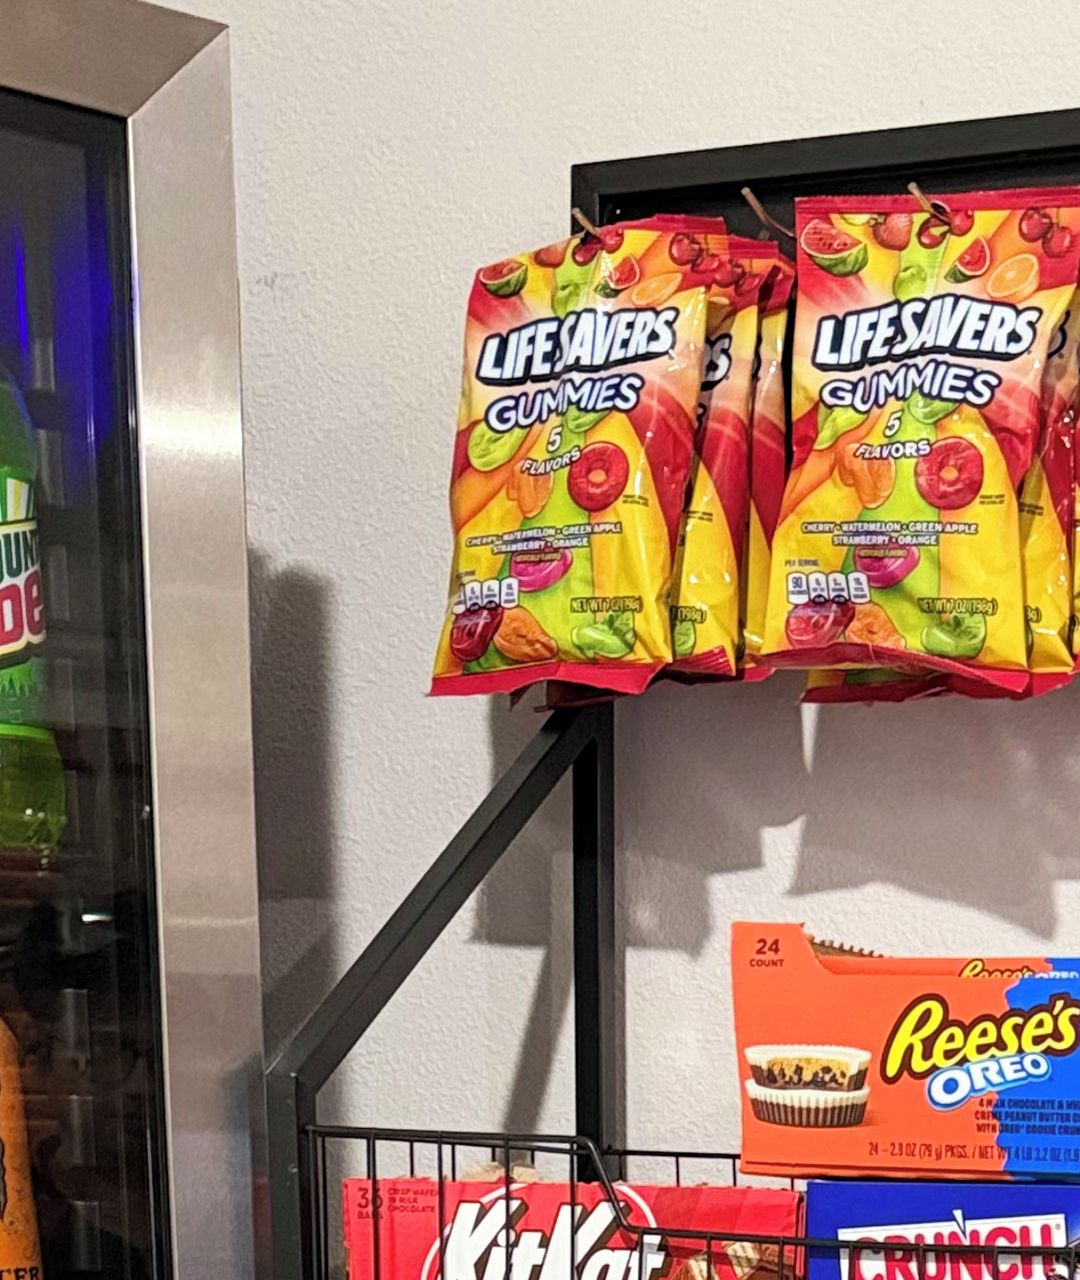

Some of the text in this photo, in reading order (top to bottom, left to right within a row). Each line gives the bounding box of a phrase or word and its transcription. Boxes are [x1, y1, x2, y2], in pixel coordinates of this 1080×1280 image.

[813, 295, 1042, 366] LIFE SAVERS
[477, 320, 559, 383] LIFE
[554, 308, 679, 371] SAVERS
[821, 361, 999, 412] GUMMIES
[486, 375, 643, 431] GUMMIES
[884, 410, 903, 436] 5
[547, 426, 562, 451] 5
[855, 440, 931, 459] FLAVORS
[521, 447, 582, 475] FLAVORS
[562, 524, 592, 536] GREEN
[802, 522, 978, 534] CHERRY WATERMELON GREEN APPLE
[552, 537, 590, 549] ORANGE
[832, 534, 938, 545] STRAWBERRY ORANGE
[755, 938, 780, 955] 24
[749, 959, 785, 968] COUNT
[929, 1053, 1051, 1107] OREO
[1004, 1111, 1071, 1122] PEANUT BUTTER
[978, 1146, 996, 1159] NET
[388, 1205, 436, 1213] CHOCOLATE
